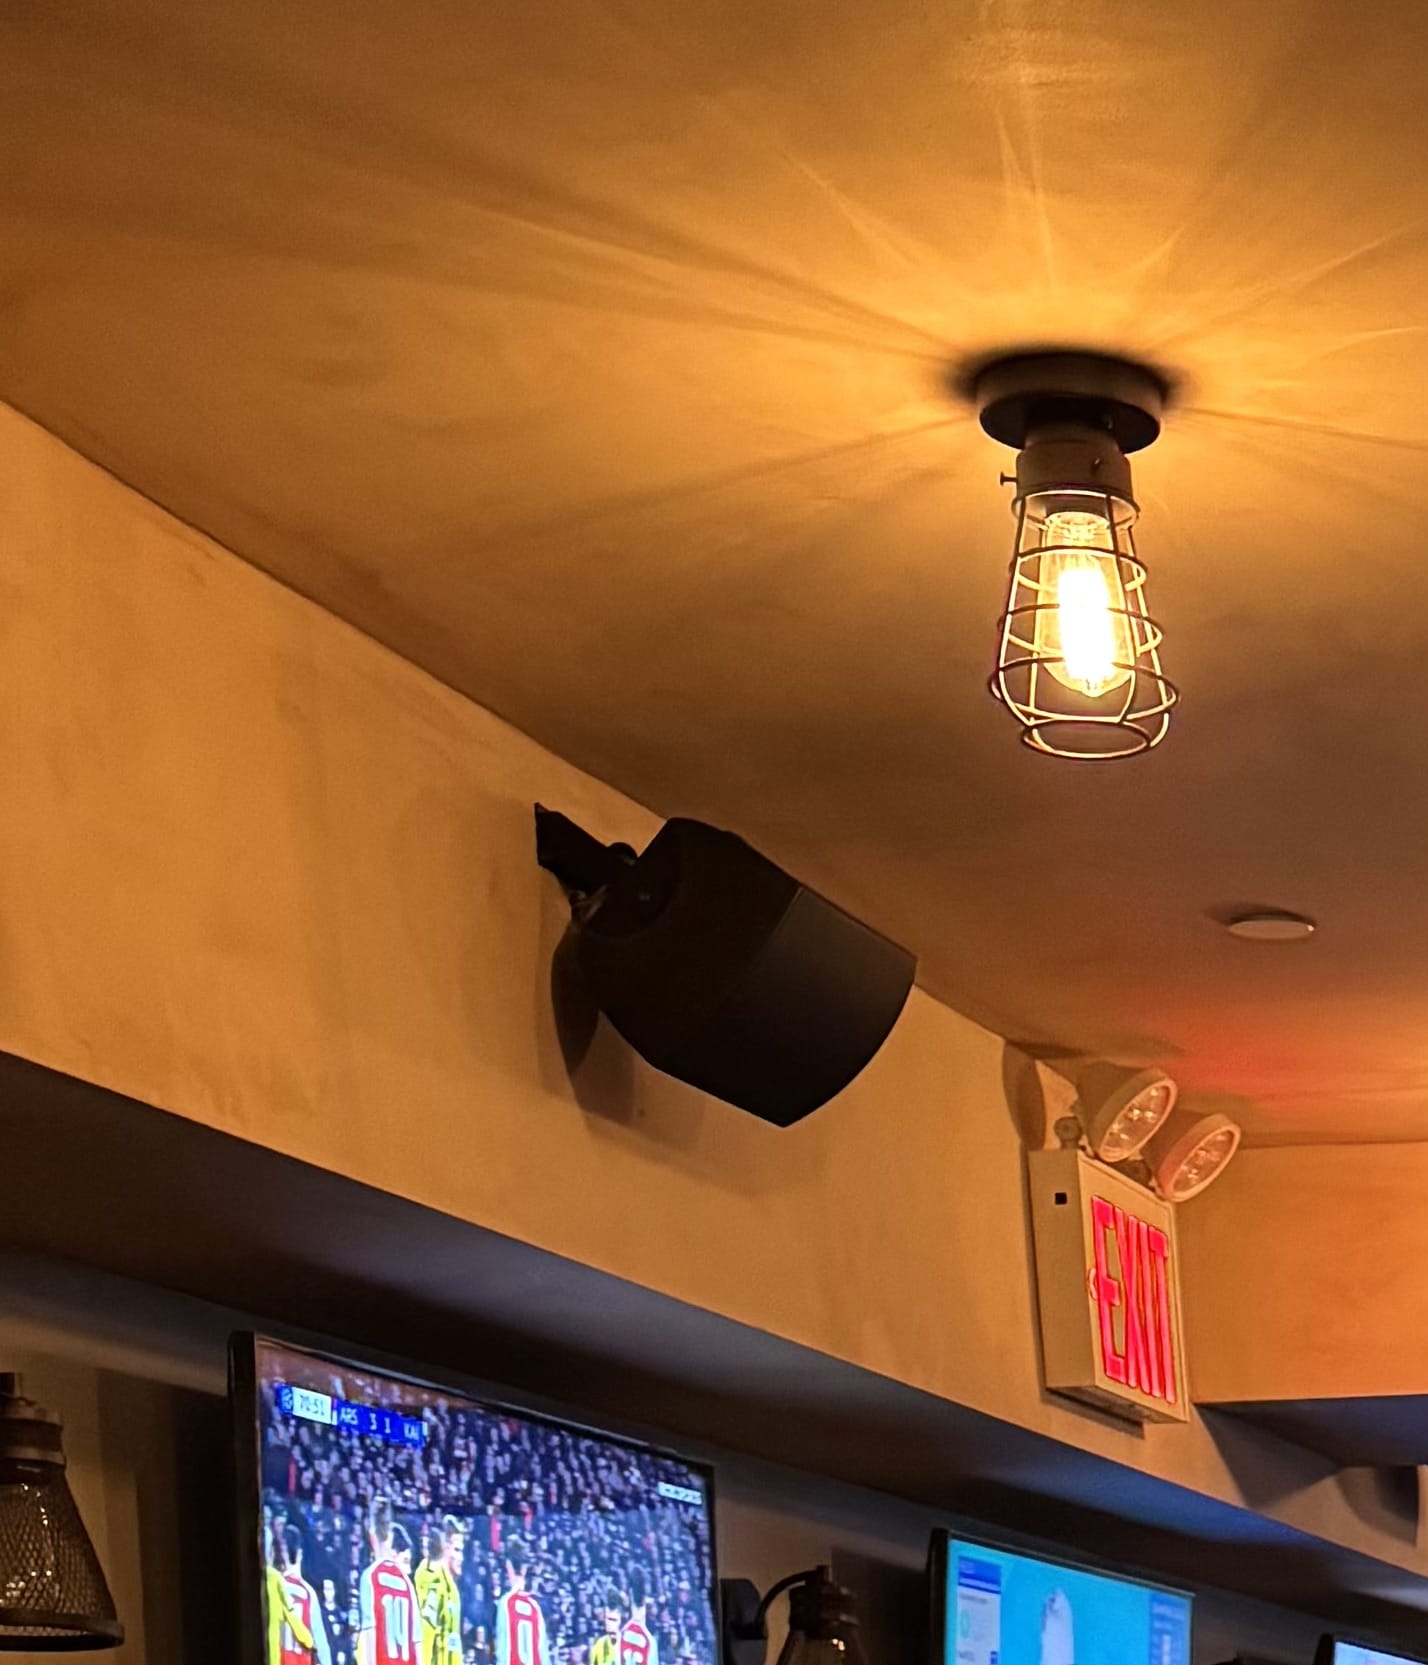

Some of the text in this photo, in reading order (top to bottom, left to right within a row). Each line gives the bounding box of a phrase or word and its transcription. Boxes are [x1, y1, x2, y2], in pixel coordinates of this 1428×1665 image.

[1091, 1194, 1176, 1404] EXIT
[339, 1407, 359, 1426] ARS
[369, 1412, 378, 1431] 3
